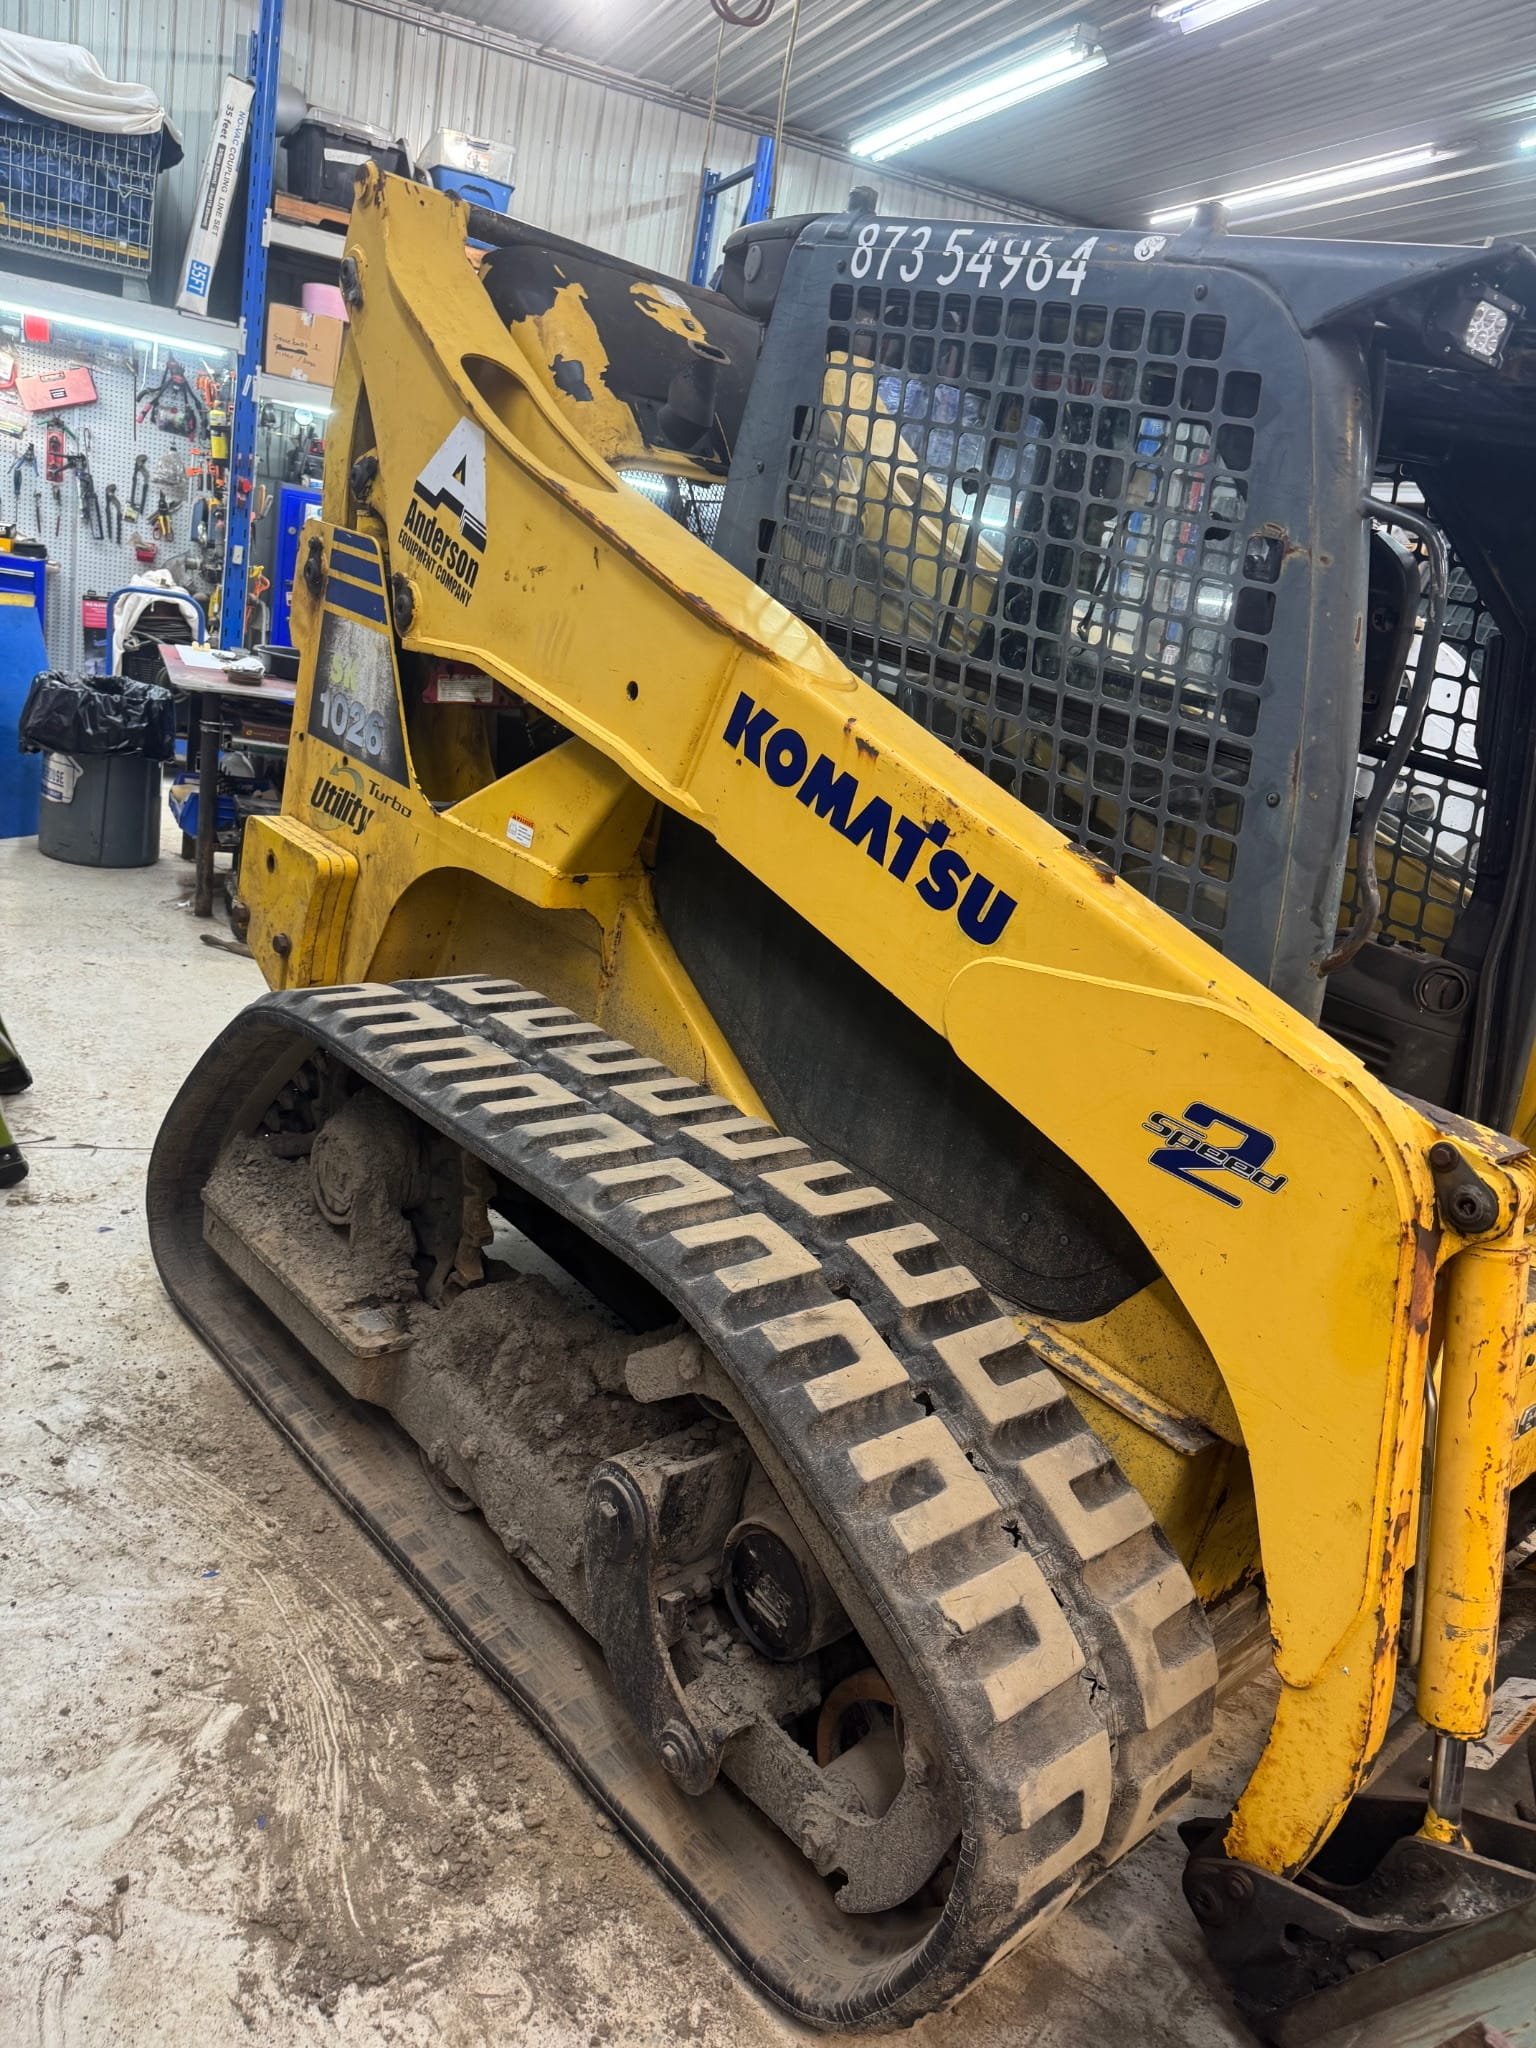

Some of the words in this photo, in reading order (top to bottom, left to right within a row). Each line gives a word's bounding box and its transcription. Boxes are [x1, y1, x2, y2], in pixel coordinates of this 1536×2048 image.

[219, 119, 232, 139] feet
[226, 104, 235, 117] 35
[232, 111, 247, 146] NO-VAC
[222, 147, 237, 193] COUPLING
[211, 218, 221, 237] SET
[215, 197, 226, 216] LINE
[851, 223, 932, 282] 873
[189, 262, 208, 294] 35FT
[403, 498, 479, 590] Anderson
[398, 529, 438, 574] EQUIPMENT
[435, 564, 472, 607] COMPANY
[320, 691, 384, 756] 1026
[310, 776, 376, 836] Utility
[368, 779, 412, 818] Turbo
[722, 691, 1018, 945] KOMATSU
[1148, 1101, 1277, 1209] 2
